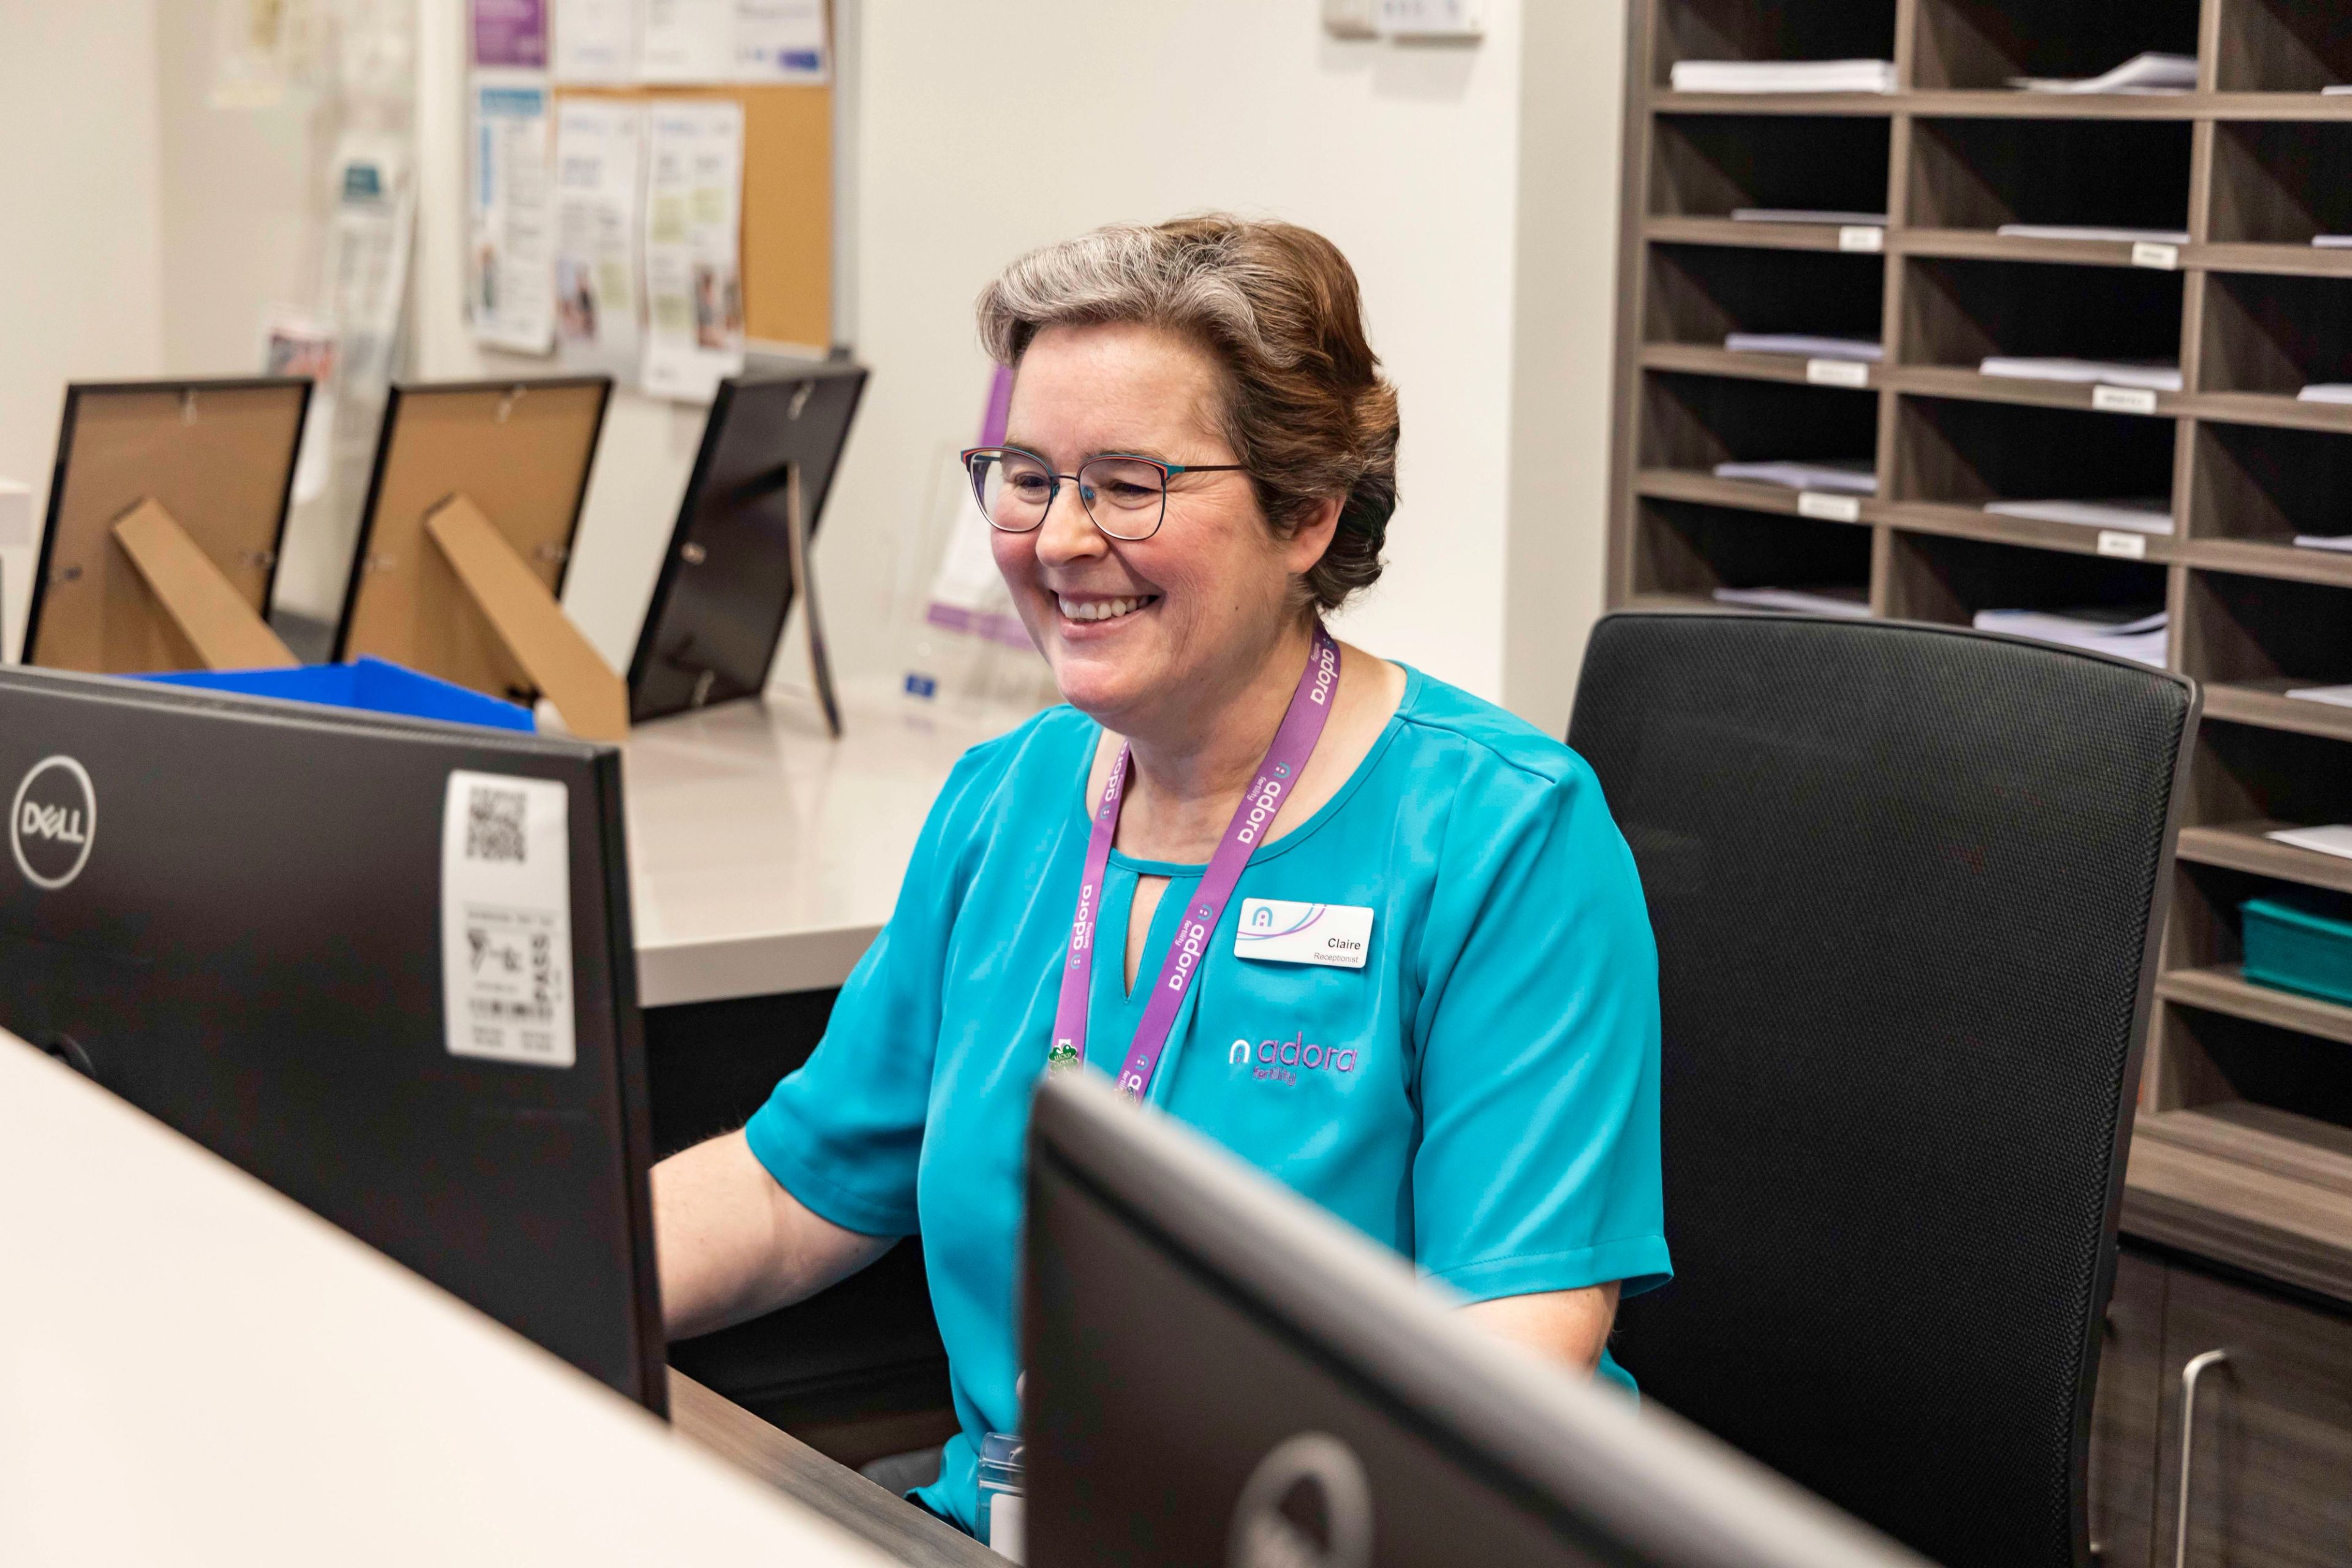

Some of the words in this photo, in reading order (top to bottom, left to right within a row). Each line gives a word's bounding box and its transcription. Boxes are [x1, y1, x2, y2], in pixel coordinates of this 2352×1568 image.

[1310, 648, 1338, 706] adora
[1246, 776, 1267, 801] fertility
[21, 800, 85, 843] DELL
[1237, 781, 1281, 844] adora
[1073, 884, 1092, 950] adora
[1175, 919, 1192, 946] fertility
[1168, 924, 1205, 991] adora
[1314, 952, 1359, 963] Receptionist
[1328, 938, 1361, 950] Claire
[1257, 1031, 1357, 1072] adora
[1253, 1066, 1295, 1086] fertility
